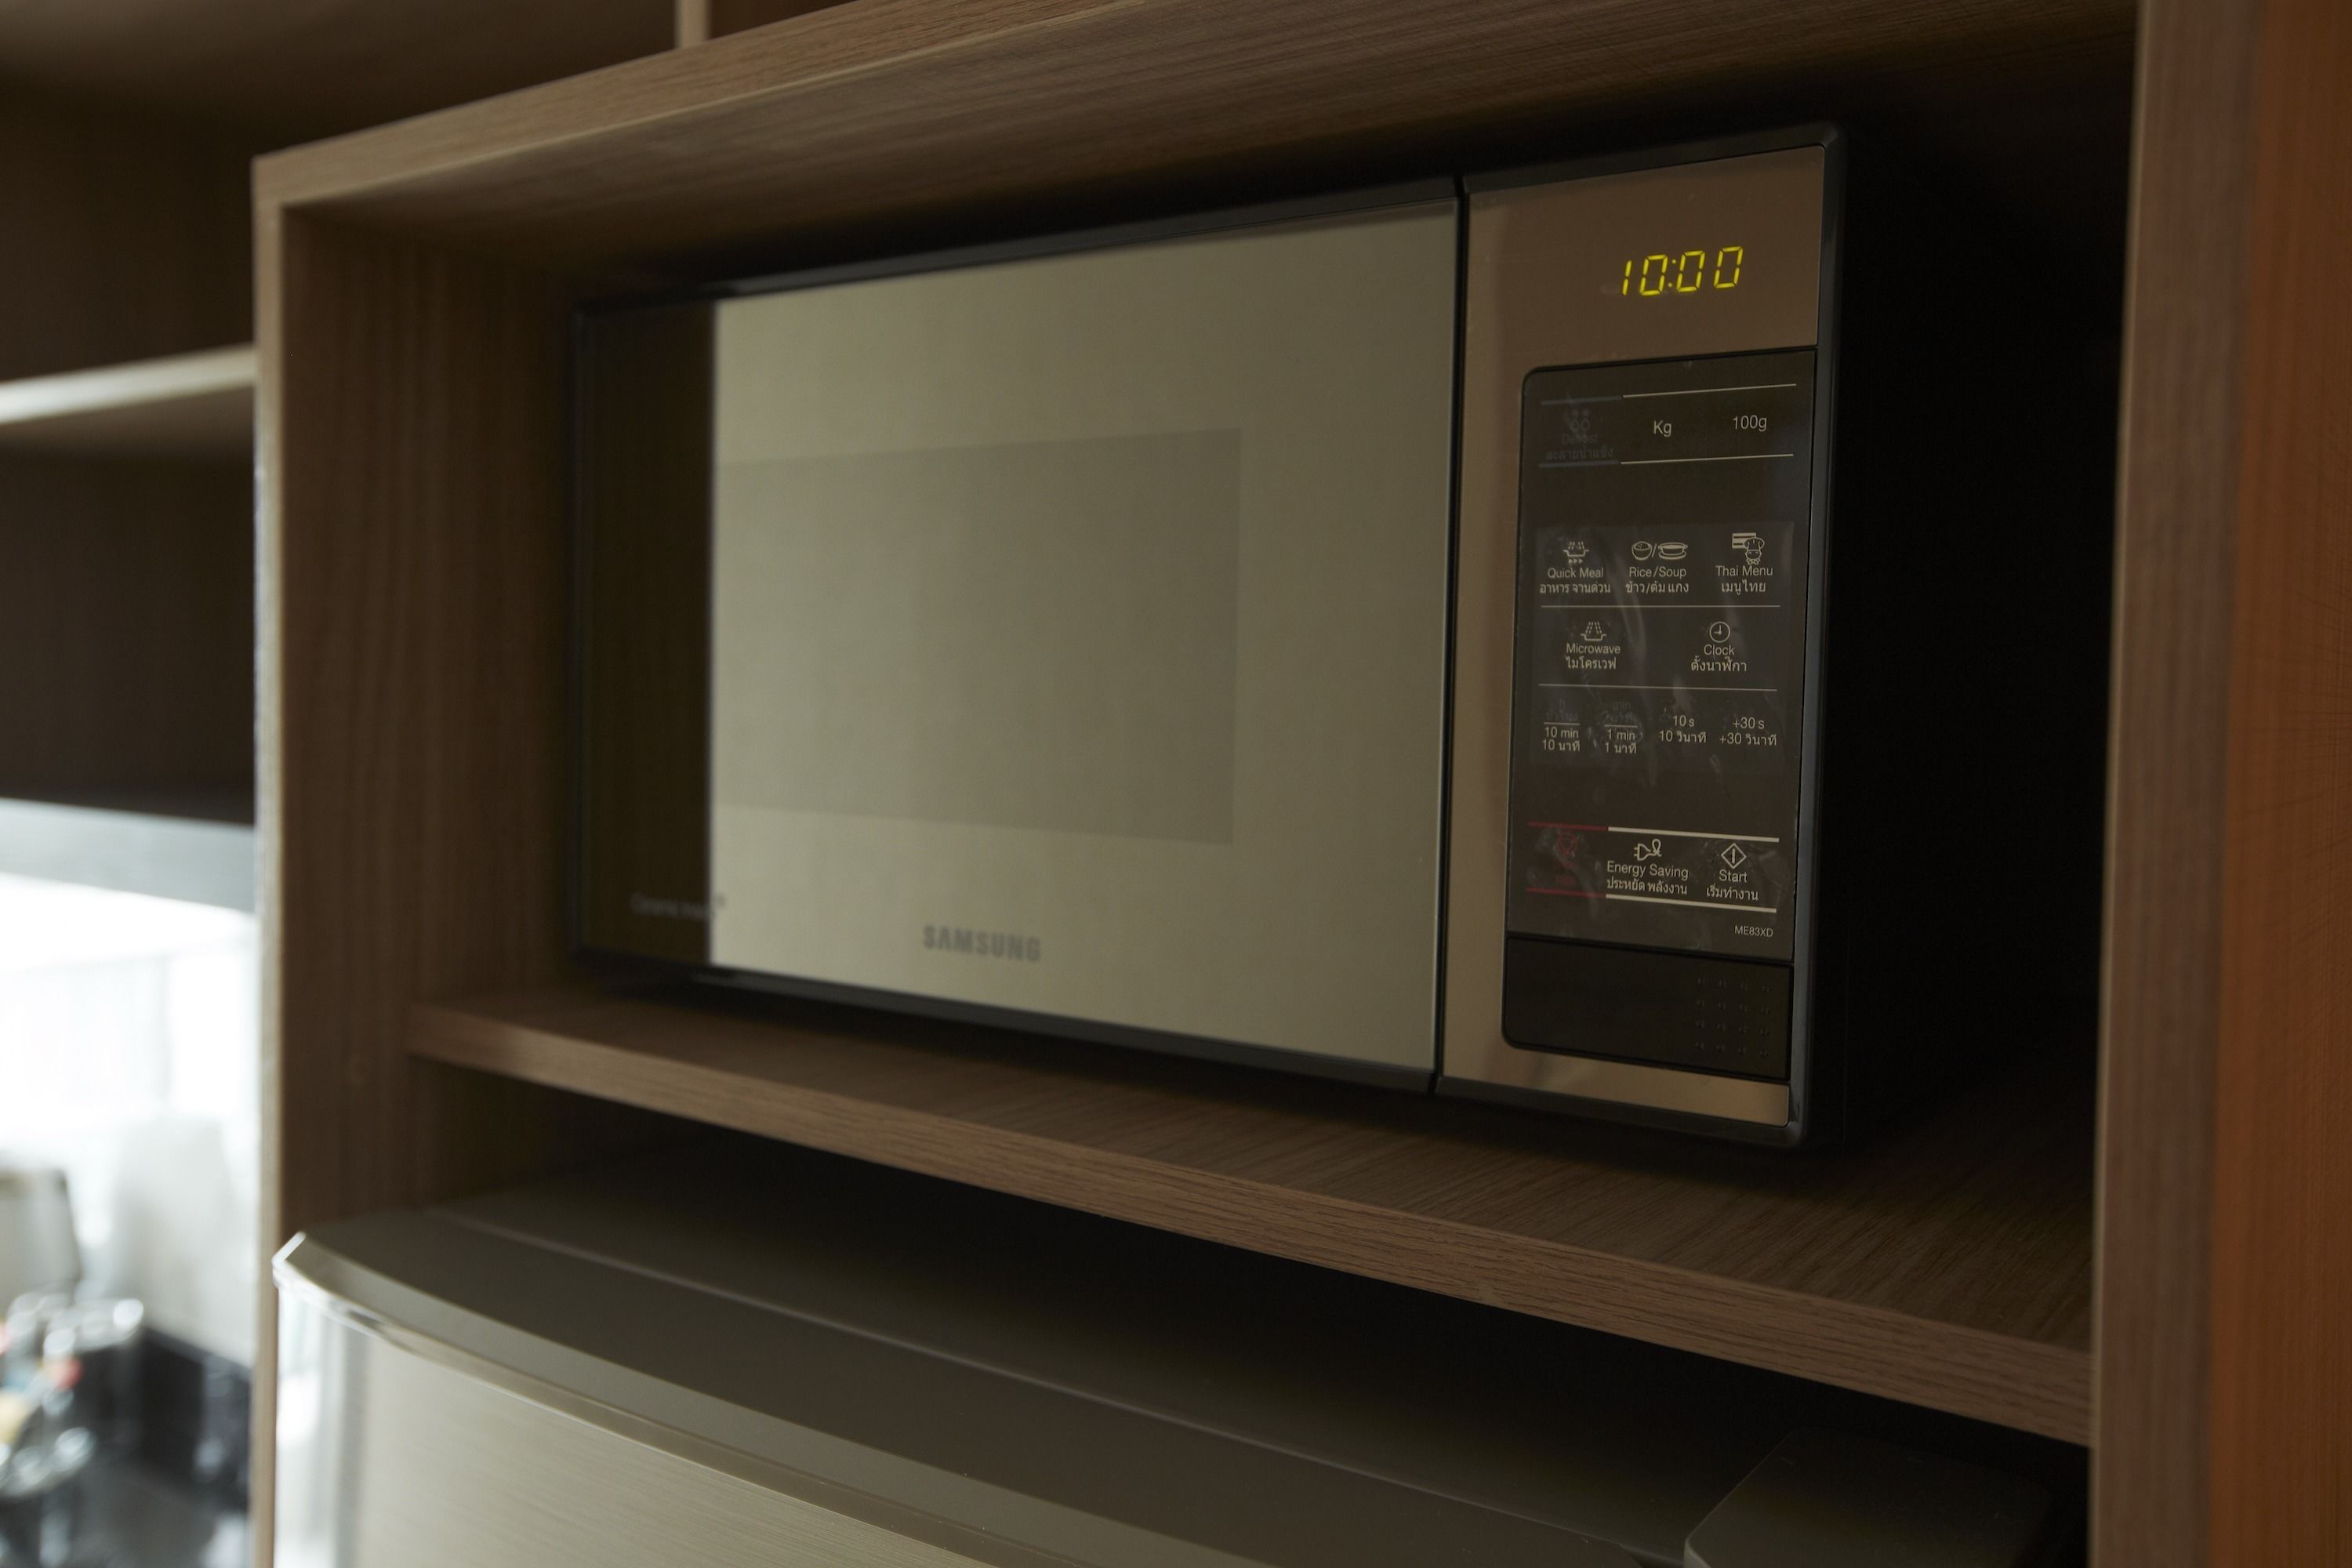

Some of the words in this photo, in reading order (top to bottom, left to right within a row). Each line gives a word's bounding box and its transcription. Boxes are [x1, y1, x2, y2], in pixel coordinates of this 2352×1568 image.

[1621, 246, 1744, 296] 10:00
[1653, 419, 1673, 437] Kg
[1732, 415, 1768, 432] 100g
[1547, 568, 1576, 579] Quick
[1579, 568, 1604, 578] Meal
[1715, 565, 1740, 576] Thai
[1742, 565, 1773, 576] Menu
[1721, 579, 1766, 595] เมนูไทย
[1566, 643, 1621, 654] Microwave
[1704, 644, 1735, 656] Clock
[1566, 655, 1617, 670] ไมโครเวฟ
[1673, 714, 1686, 727] 10
[1733, 717, 1755, 729] +30
[1544, 726, 1558, 739] 10
[1560, 727, 1579, 739] min
[1607, 728, 1612, 740] 1
[1616, 729, 1635, 741] min
[1659, 730, 1673, 742] 10
[1676, 730, 1708, 743] วินาที
[1719, 732, 1742, 745] +30
[1745, 731, 1777, 746] วินาที
[1542, 739, 1555, 751] 10
[1558, 740, 1581, 752] นาที
[1614, 742, 1637, 754] นาที
[1606, 860, 1646, 878] Energy
[1649, 864, 1690, 880] Saving
[1719, 869, 1748, 883] Start
[1734, 924, 1774, 938] ME83XD
[923, 924, 1041, 962] SAMSUNG
